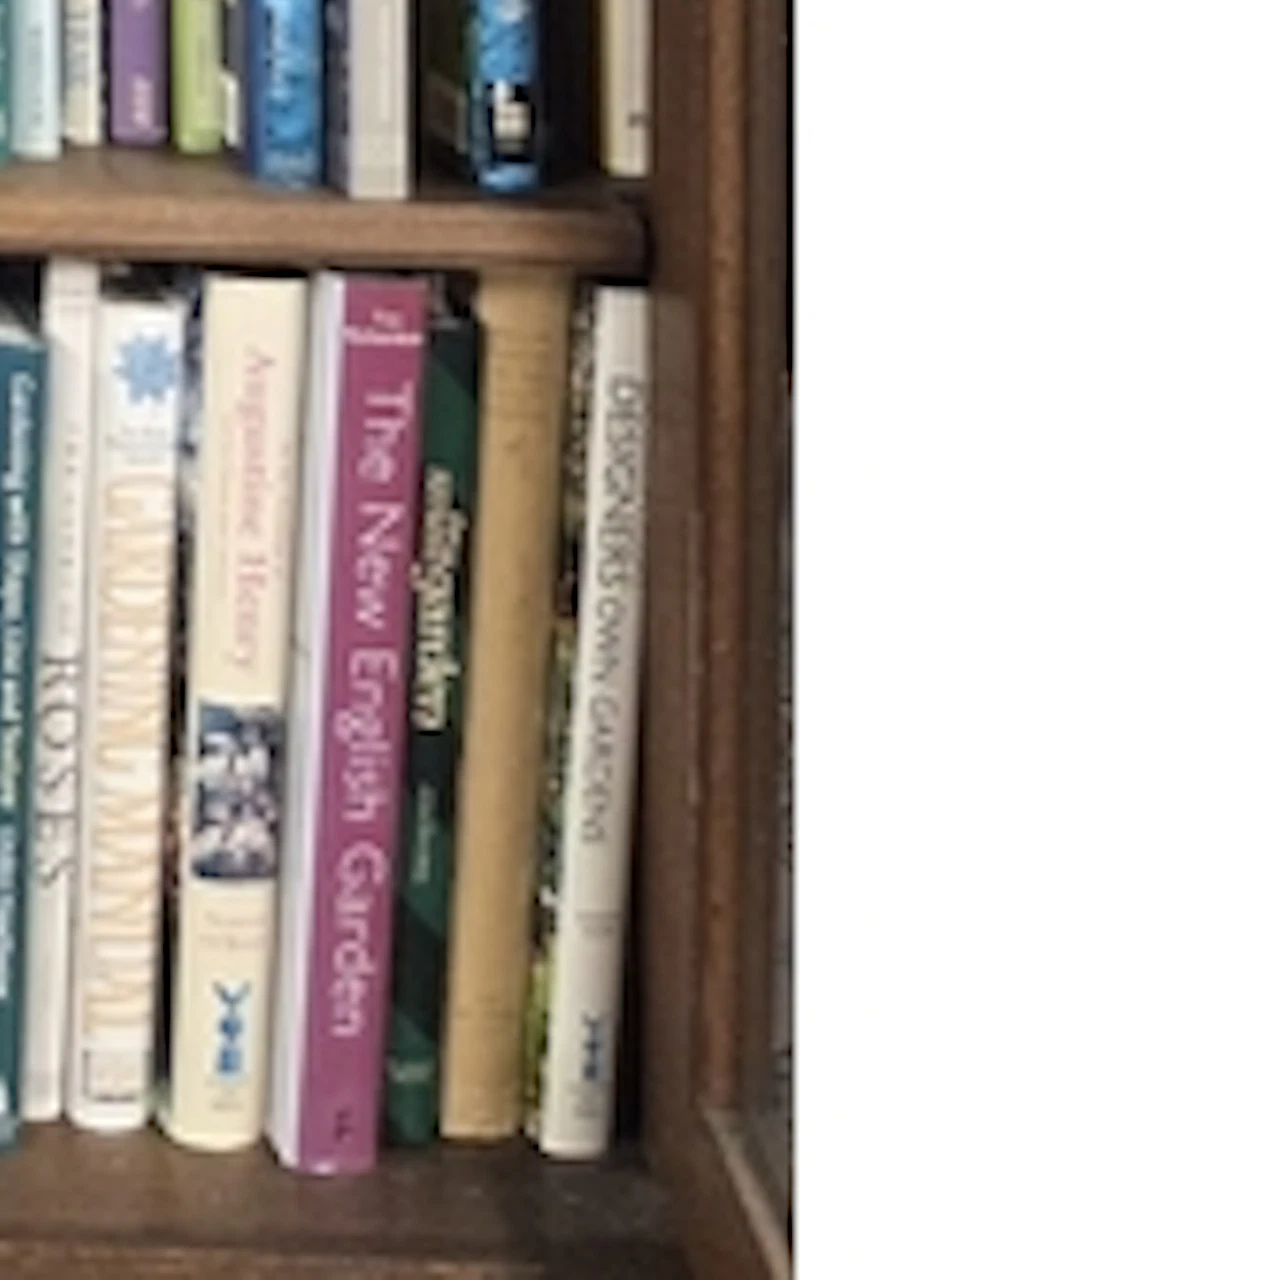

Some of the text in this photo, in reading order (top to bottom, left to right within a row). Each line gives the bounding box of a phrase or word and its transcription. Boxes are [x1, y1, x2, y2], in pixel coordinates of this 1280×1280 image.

[0, 369, 32, 491] Gardening
[4, 494, 28, 545] with
[228, 345, 278, 672] Augustine Henry
[0, 678, 24, 721] and
[330, 380, 414, 1040] The New English Garden
[591, 595, 627, 686] OWN
[36, 655, 84, 891] ROSES
[86, 474, 166, 1038] GARDENING MANUAL
[580, 694, 615, 843] GARDENS
